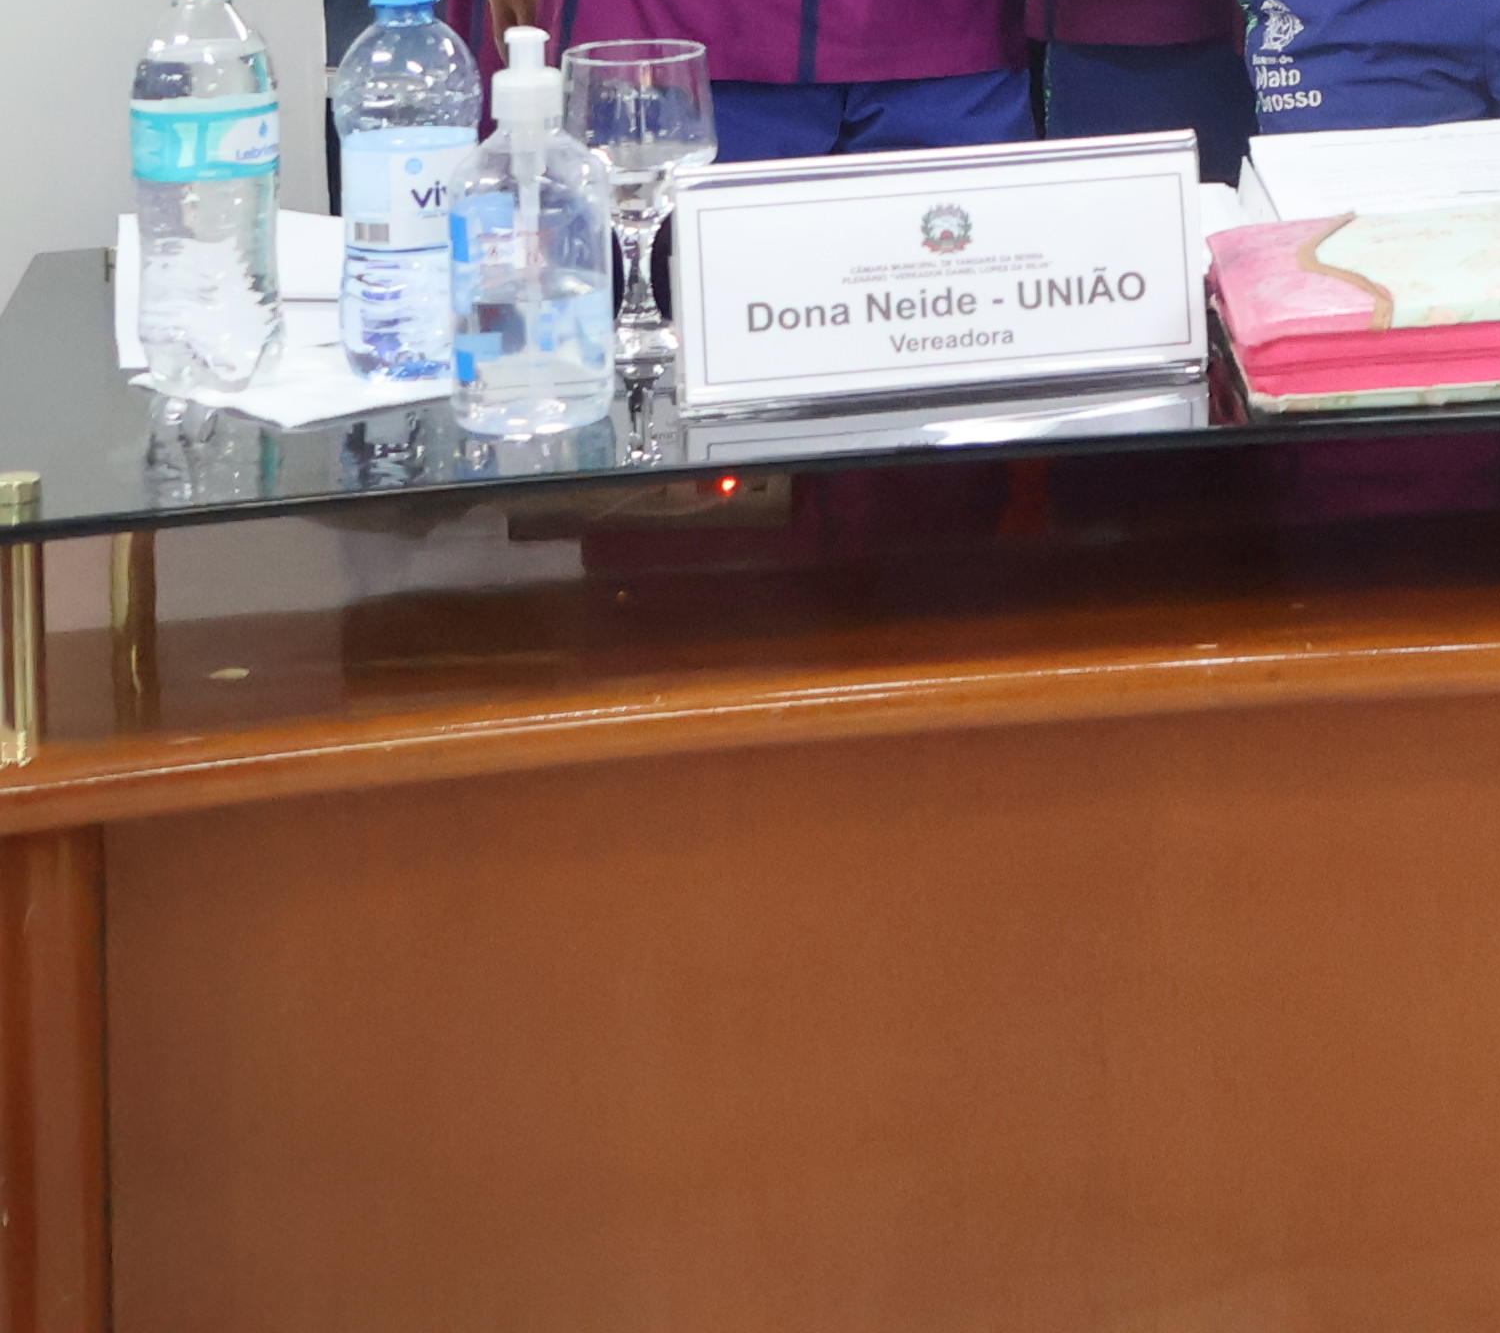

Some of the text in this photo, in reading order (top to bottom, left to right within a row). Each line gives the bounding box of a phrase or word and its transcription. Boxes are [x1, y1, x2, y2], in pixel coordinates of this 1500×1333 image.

[747, 298, 851, 333] Dona
[867, 284, 978, 323] Neide
[1017, 266, 1147, 310] UNIÃO
[889, 326, 1015, 354] Vereadora
